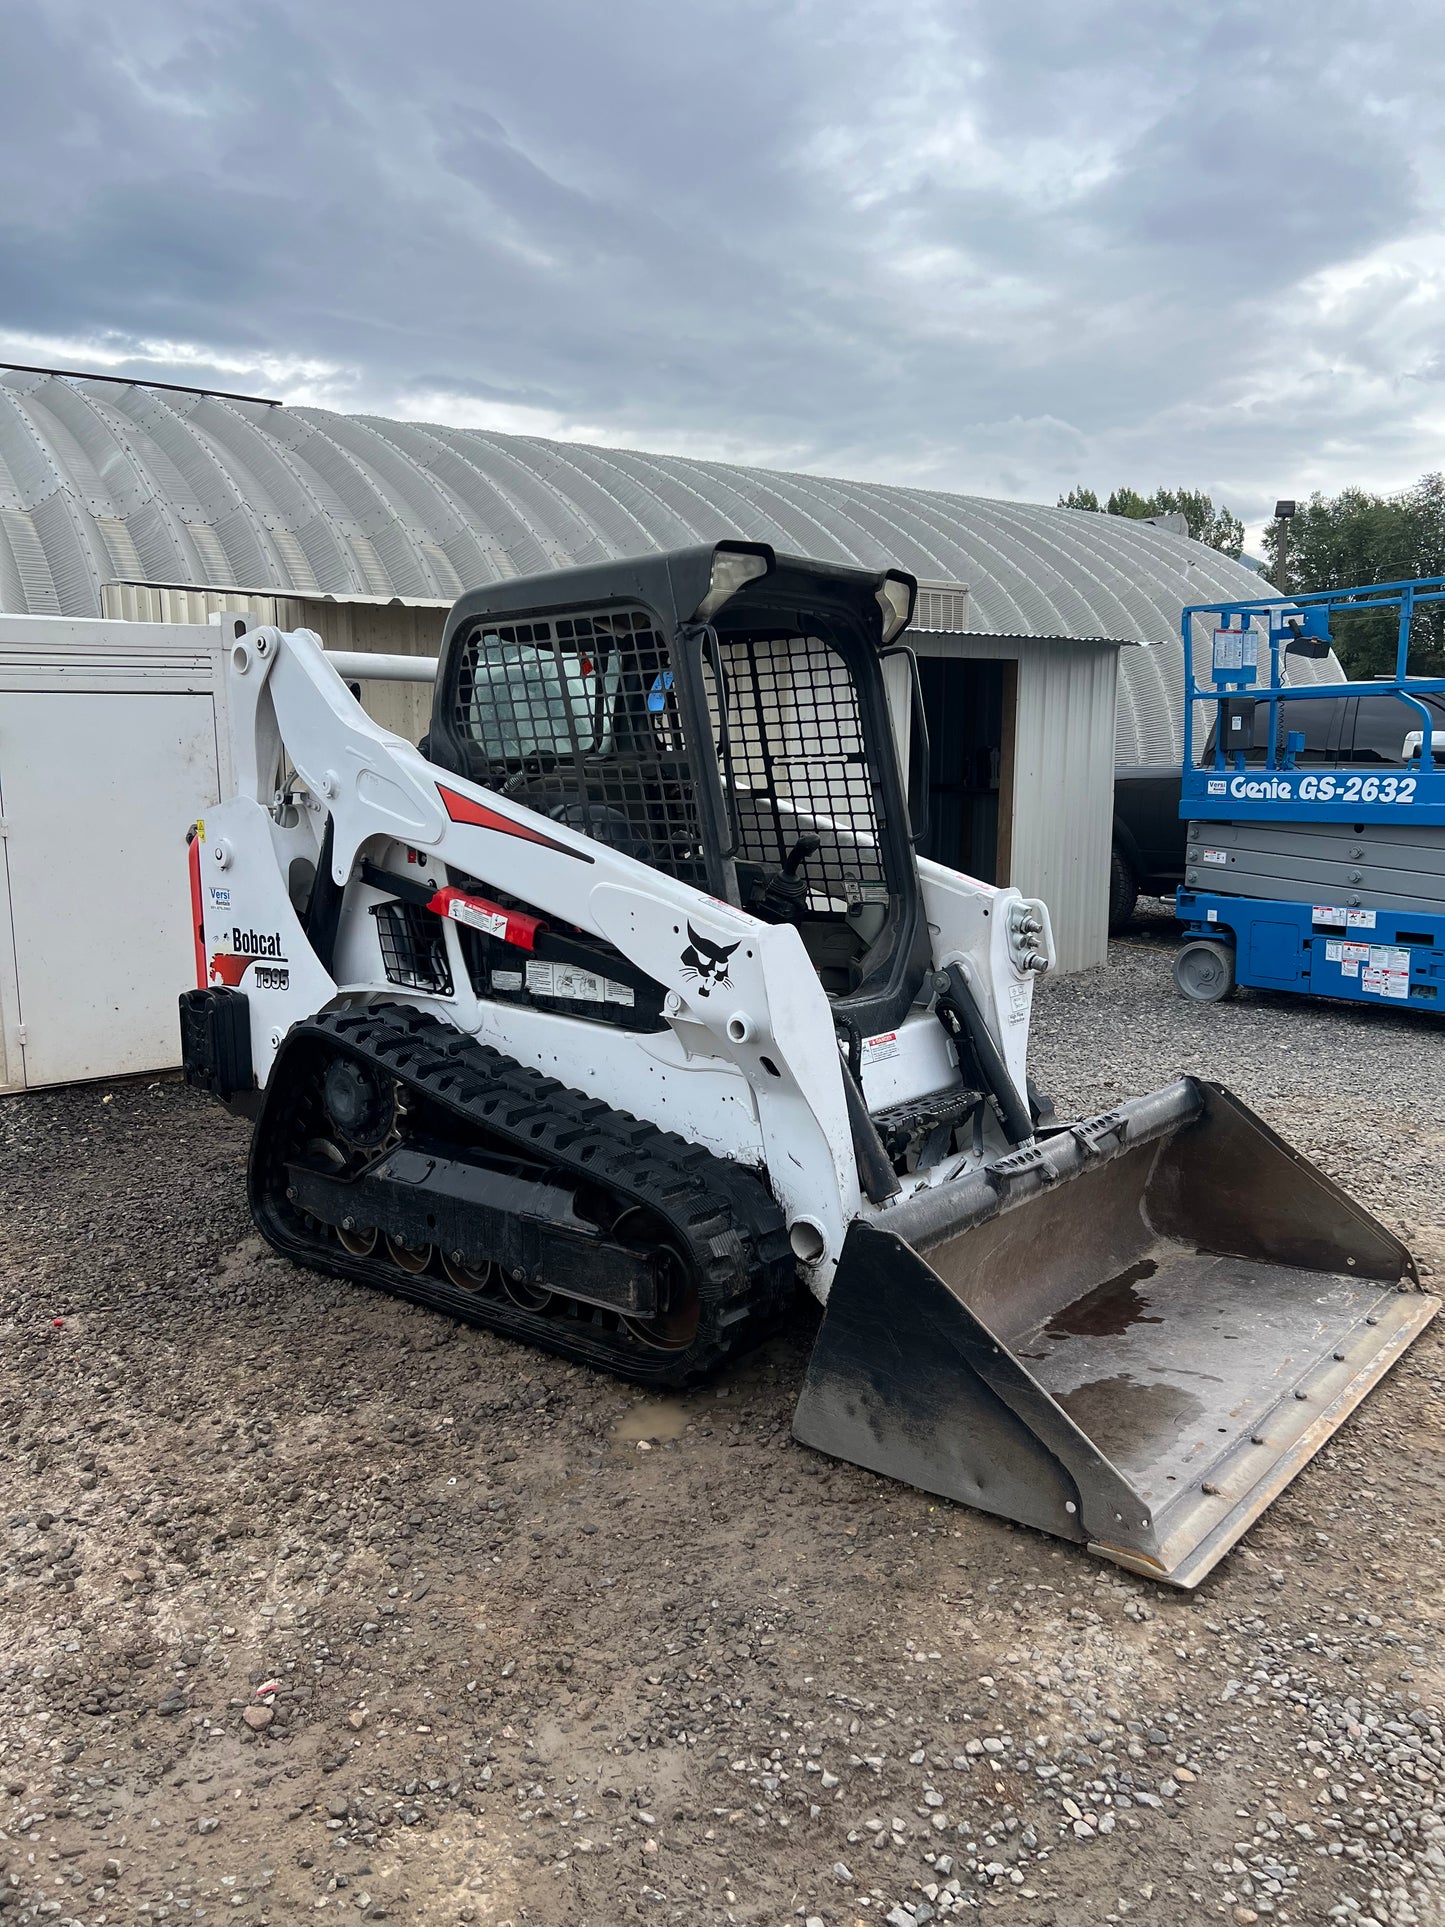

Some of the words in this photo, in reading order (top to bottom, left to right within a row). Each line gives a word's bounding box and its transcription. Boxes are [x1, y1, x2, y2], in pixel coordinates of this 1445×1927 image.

[1231, 776, 1292, 799] Genie
[1299, 776, 1417, 803] GS-2632
[210, 888, 230, 900] Versi
[232, 927, 282, 957] Bobcat
[255, 966, 290, 990] T595
